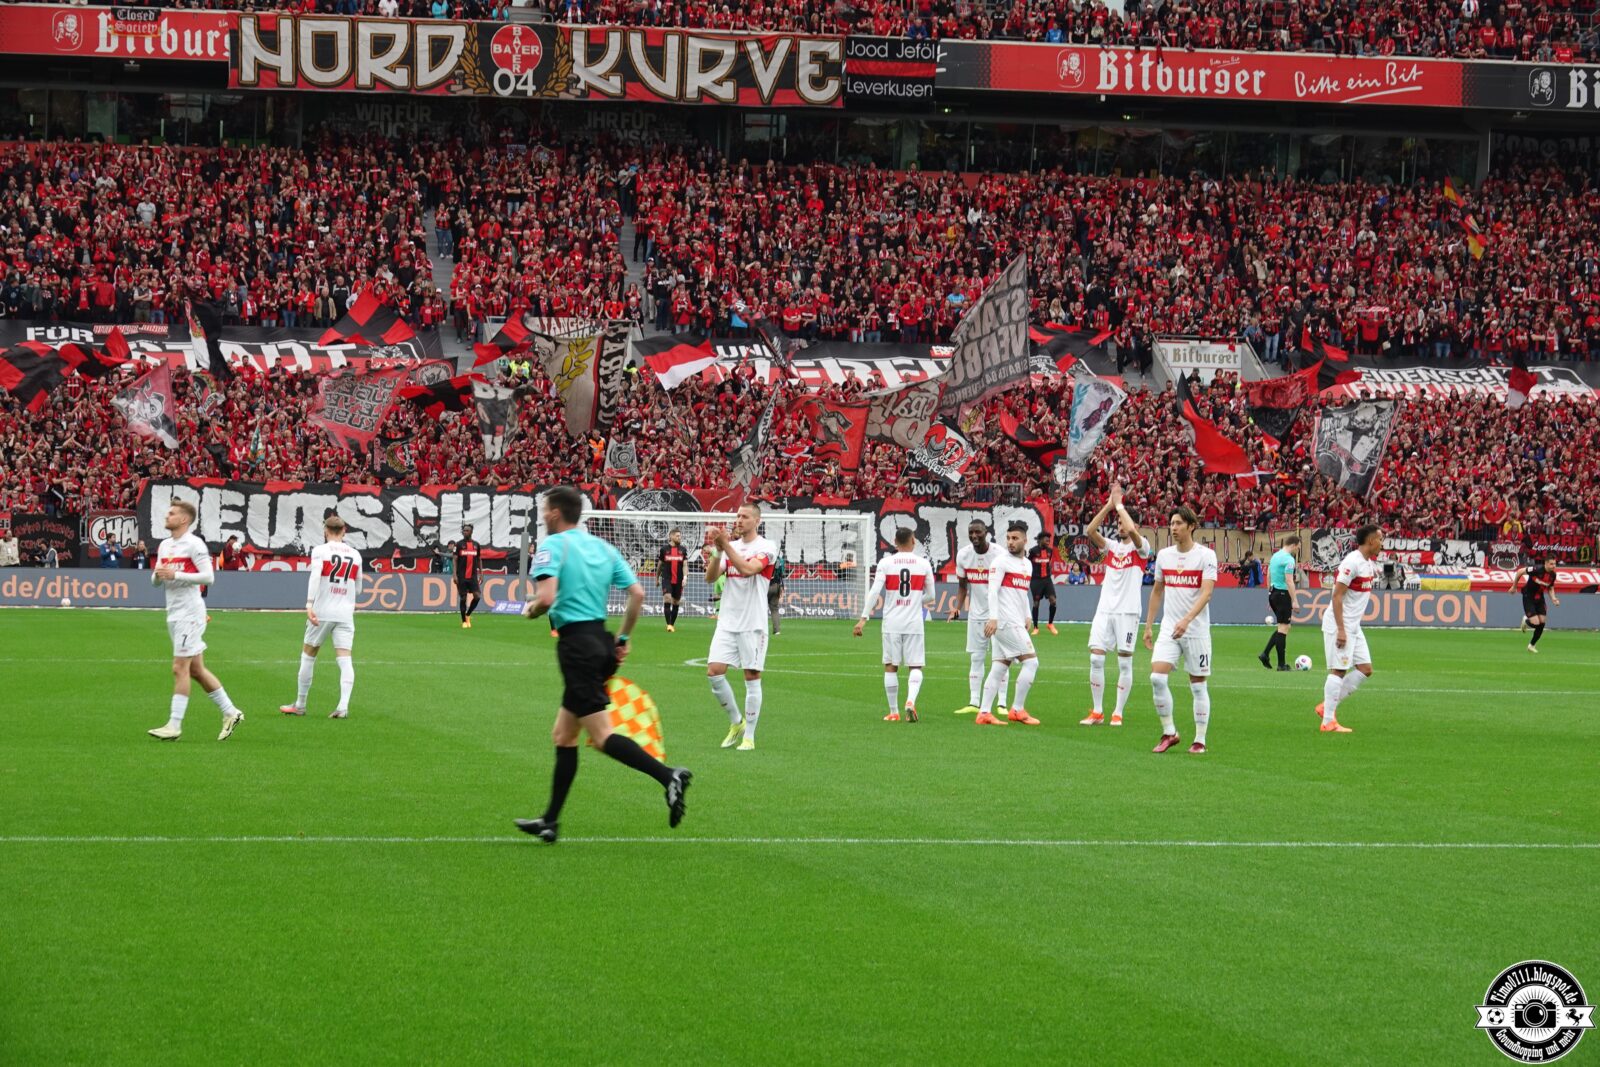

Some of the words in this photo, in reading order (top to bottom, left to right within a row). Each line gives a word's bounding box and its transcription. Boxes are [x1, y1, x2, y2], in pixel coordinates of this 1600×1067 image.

[117, 8, 155, 21] Closed
[114, 21, 158, 34] Society
[492, 44, 540, 56] BAYER
[846, 40, 889, 59] Jood
[570, 28, 845, 105] KURVE
[1096, 49, 1266, 96] Bitburger
[492, 68, 537, 96] 04
[846, 79, 933, 98] Leverkusen
[1294, 71, 1342, 98] Bitte
[1346, 71, 1382, 90] ein
[1385, 61, 1424, 86] Bit
[26, 325, 94, 343] FÜR
[1172, 347, 1239, 364] Bitburger
[910, 482, 940, 496] 2009
[330, 553, 354, 584] 27
[1, 574, 129, 600] de/ditcon
[899, 568, 911, 598] 8
[1164, 574, 1199, 586] WINAMAX
[804, 605, 835, 617] trive
[180, 634, 188, 648] 7
[1199, 653, 1209, 668] 21
